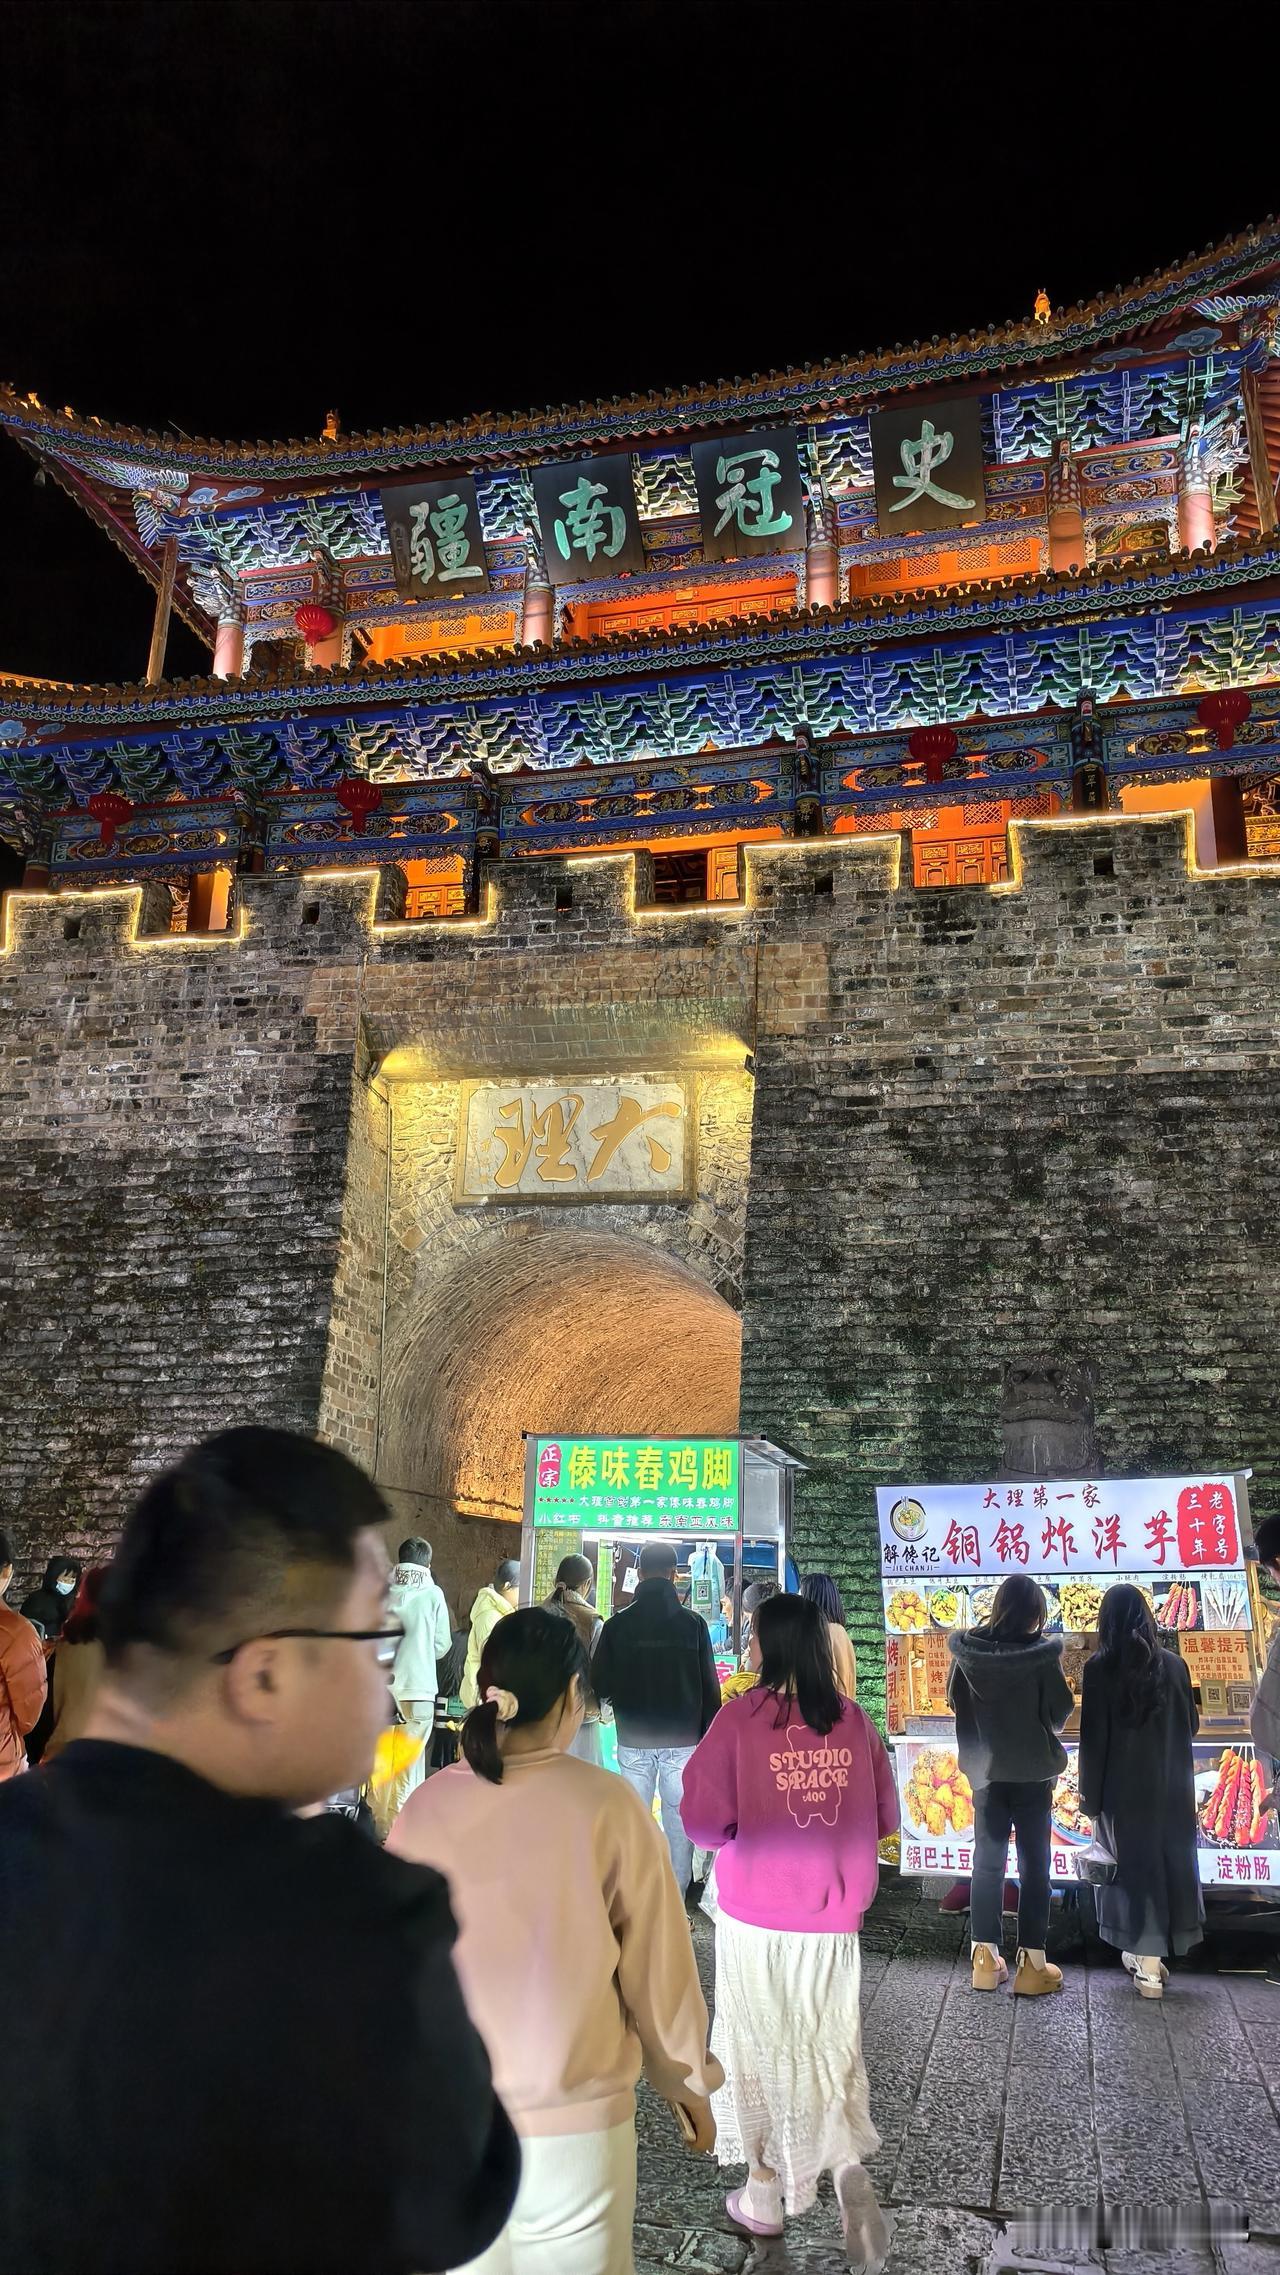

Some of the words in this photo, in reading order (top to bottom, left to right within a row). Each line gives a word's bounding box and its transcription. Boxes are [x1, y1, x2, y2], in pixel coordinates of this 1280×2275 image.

[541, 1446, 559, 1487] 正宗
[983, 1483, 1101, 1510] 大理第一家
[941, 1510, 1176, 1567] 铜锅炸洋芋
[1186, 1494, 1208, 1561] 三十年
[1209, 1491, 1229, 1560] 老字号
[884, 1544, 940, 1564] 解馋记
[1184, 1637, 1249, 1653] 温馨提示
[770, 1748, 852, 1771] STUDIO
[776, 1768, 848, 1791] SPACE
[906, 1845, 972, 1871] 锅巴土豆
[1216, 1854, 1271, 1881] 淀粉肠
